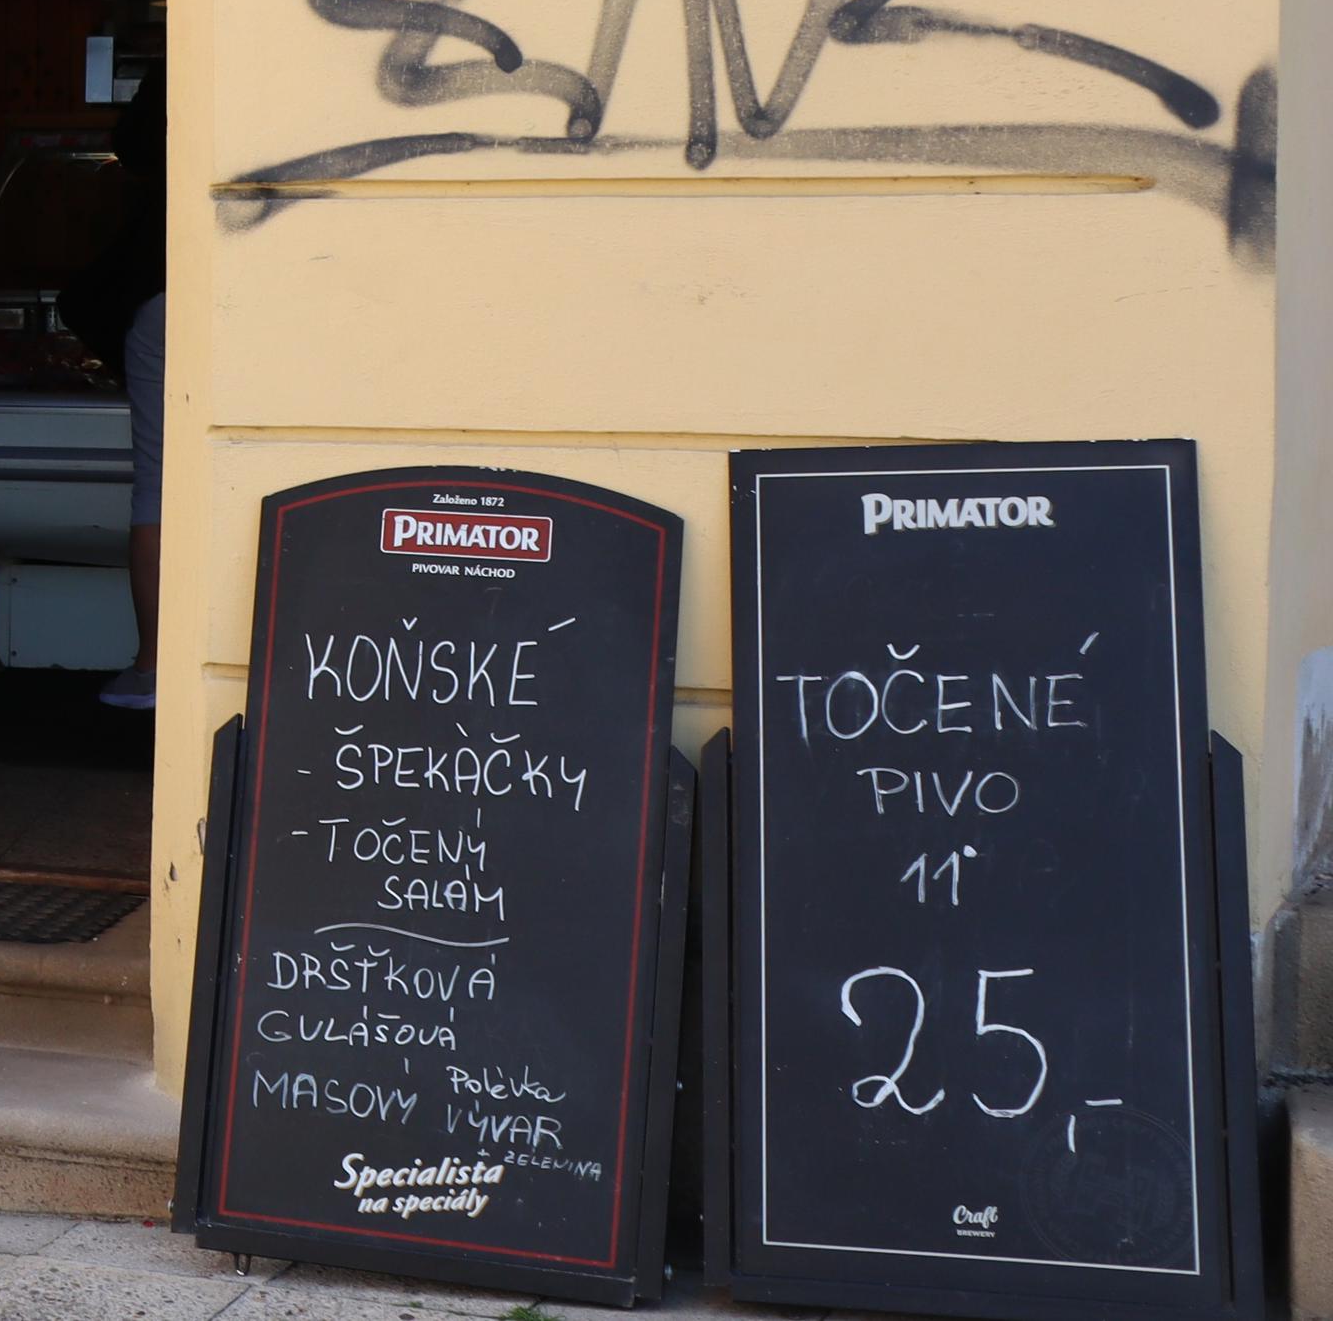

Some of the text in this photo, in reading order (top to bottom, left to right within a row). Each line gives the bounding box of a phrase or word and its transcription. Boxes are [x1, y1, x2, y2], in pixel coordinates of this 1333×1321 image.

[432, 494, 505, 507] Založeno 1872
[412, 563, 516, 579] PIVOVAR NÁCHOD
[305, 616, 576, 708] KOŇSKÉ
[775, 631, 1100, 750] TOČENÉ
[856, 767, 1020, 817] PIVO
[333, 1153, 505, 1197] Specialista
[357, 1186, 491, 1220] na speciály
[953, 1204, 999, 1229] Craft
[956, 1229, 996, 1238] BREWERY
